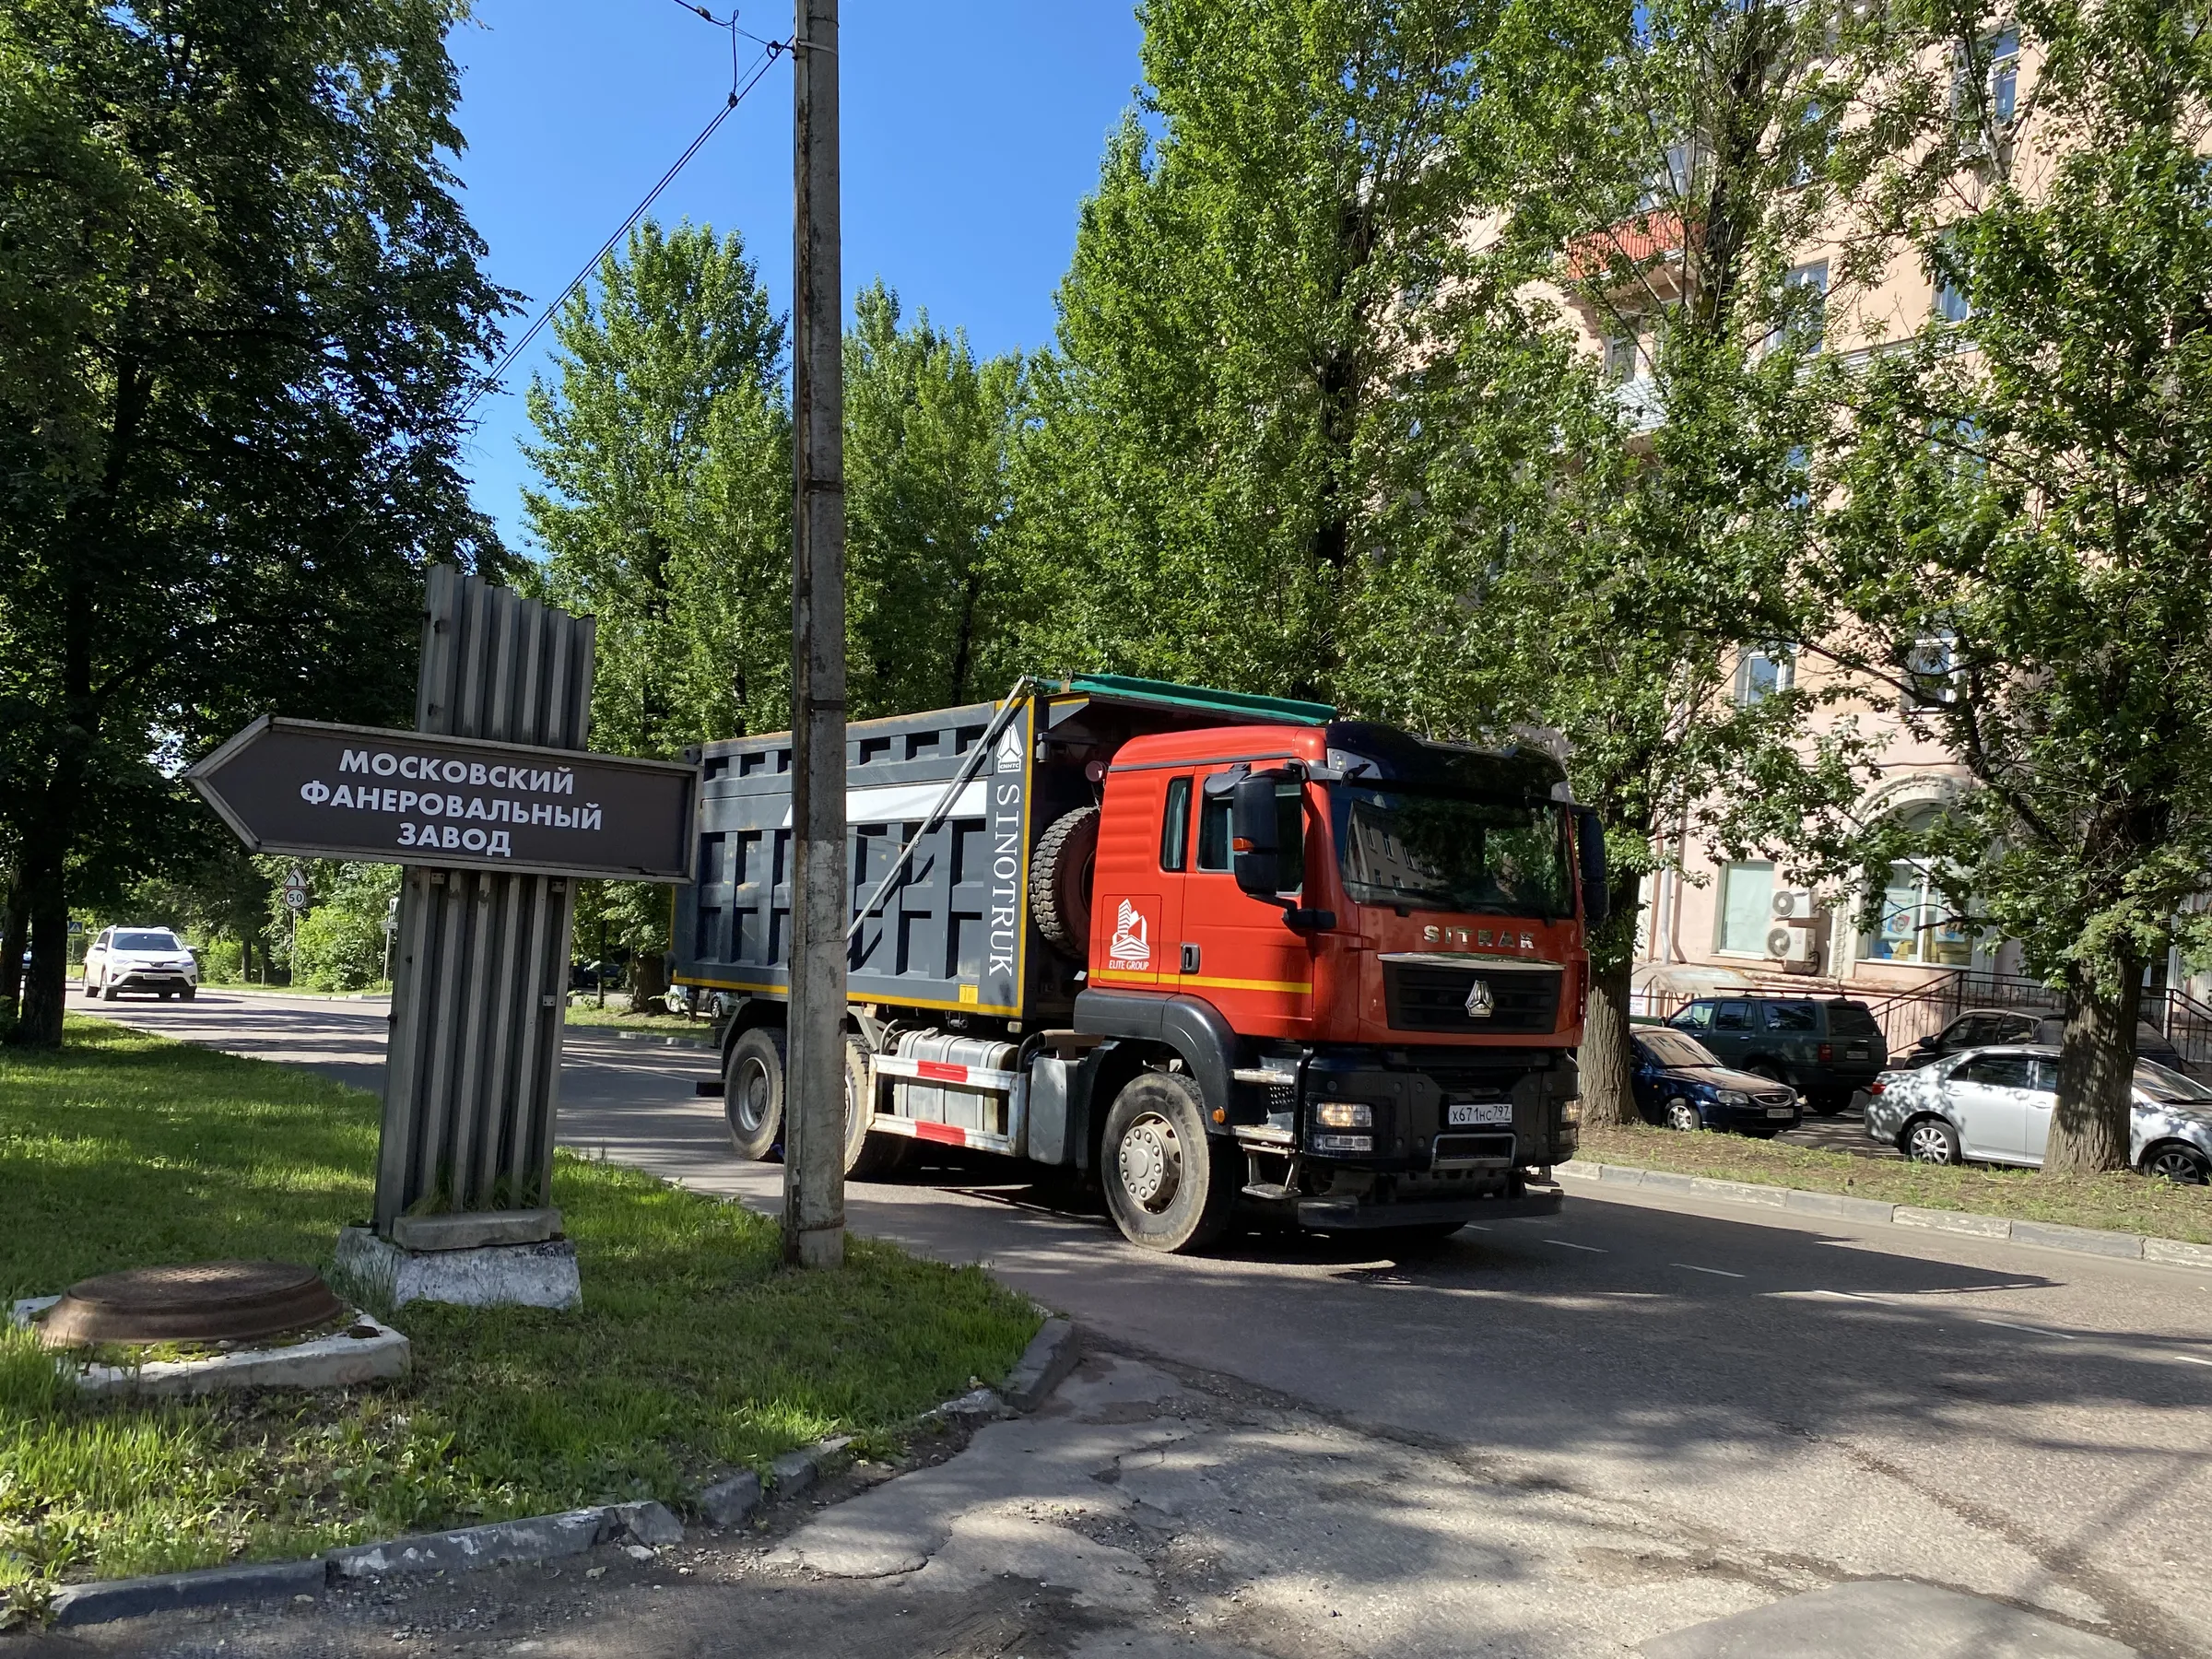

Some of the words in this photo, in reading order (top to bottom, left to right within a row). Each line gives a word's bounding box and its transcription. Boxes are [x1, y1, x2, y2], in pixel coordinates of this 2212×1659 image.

[338, 748, 574, 794] МОСКОВСКИЙ
[300, 780, 602, 830] ФАНЕРОВАЛЬНЫЙ
[396, 822, 512, 858] ЗАВОД
[288, 893, 302, 902] 50
[989, 783, 1020, 977] SINOTRUK
[1423, 924, 1535, 949] SITRAK
[1109, 959, 1125, 970] ELITE
[1126, 960, 1149, 971] GROUP
